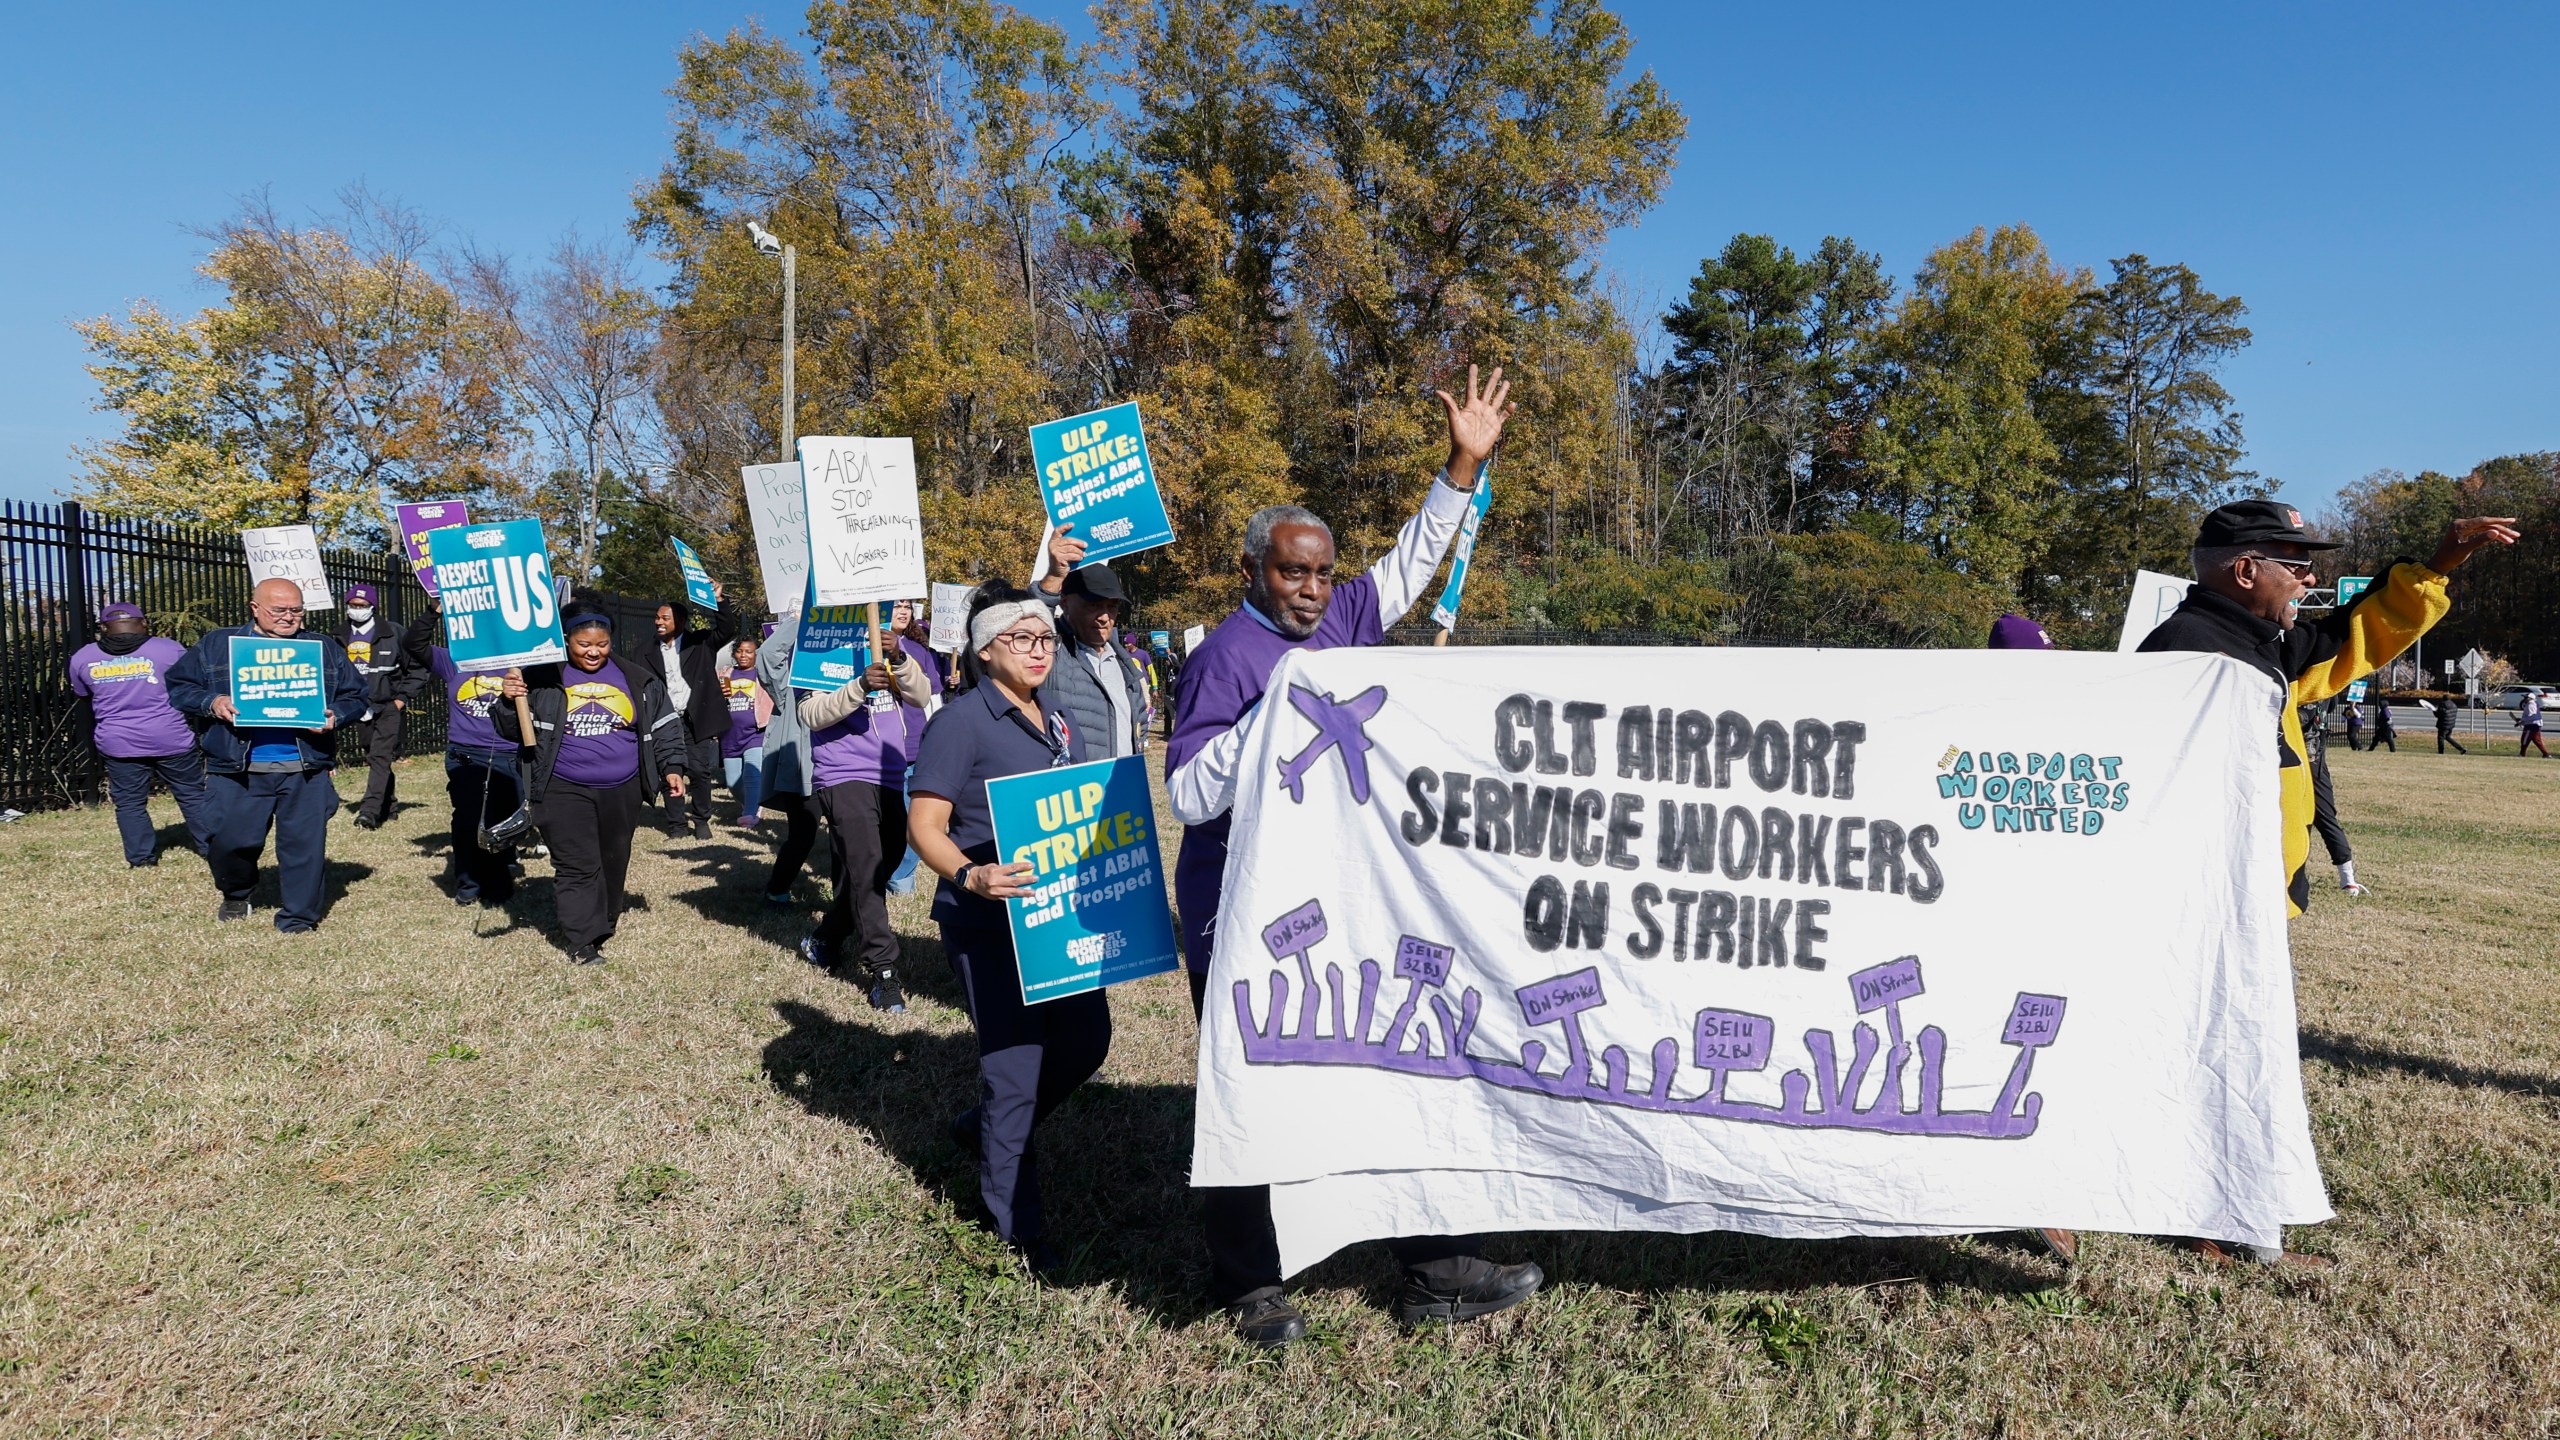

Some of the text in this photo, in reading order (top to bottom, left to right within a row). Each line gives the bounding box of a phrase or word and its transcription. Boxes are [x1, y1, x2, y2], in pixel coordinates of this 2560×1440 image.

[1061, 420, 1108, 453] ULP
[1046, 434, 1139, 487] STRIKE:
[758, 468, 803, 499] Pros
[1054, 455, 1142, 505] Against ABM
[831, 489, 873, 511] STOP
[1057, 470, 1145, 519] and Prospect
[836, 513, 918, 534] THREATENING
[1090, 517, 1128, 532] AIRPORT
[1091, 522, 1134, 539] WORKERS
[246, 528, 298, 548] CLT
[769, 532, 791, 549] on
[1099, 530, 1130, 543] UNITED
[248, 548, 315, 563] WORKERS
[269, 562, 299, 576] ON
[436, 559, 489, 588] RESPECT
[778, 558, 802, 576] for
[442, 585, 496, 615] PROTECT
[491, 552, 554, 631] US
[448, 614, 475, 640] PAY
[944, 617, 959, 626] ON
[806, 626, 853, 639] Against
[804, 638, 827, 649] and
[256, 647, 296, 664] ULP
[238, 663, 317, 682] STRIKE:
[239, 679, 317, 694] Against ABM
[240, 688, 318, 700] and Prospect
[567, 713, 623, 723] USTICE IS
[574, 727, 612, 737] FLIGHT
[1495, 693, 1866, 799] CLT AIRPORT
[1954, 751, 2122, 782] AIRPORT
[1936, 772, 2130, 811] WORKERS
[1035, 782, 1104, 832] ULP
[1959, 802, 2104, 836] UNITED
[1013, 811, 1147, 876] STRIKE:
[1401, 766, 1944, 904] SERVICE WORKERS
[1021, 846, 1149, 908] Against ABM
[1024, 868, 1153, 929] and Prospect
[1523, 875, 1831, 971] ON STRIKE
[1066, 937, 1128, 959] WORKERS
[1067, 930, 1122, 948] AIRPORT
[1076, 949, 1121, 967] UNITED
[1405, 942, 1443, 960] SEIU
[2017, 1001, 2054, 1017] SEIU
[1704, 1017, 1753, 1038] SEIU
[2014, 1019, 2050, 1034] 32BJ
[1706, 1043, 1751, 1059] 32BJ
